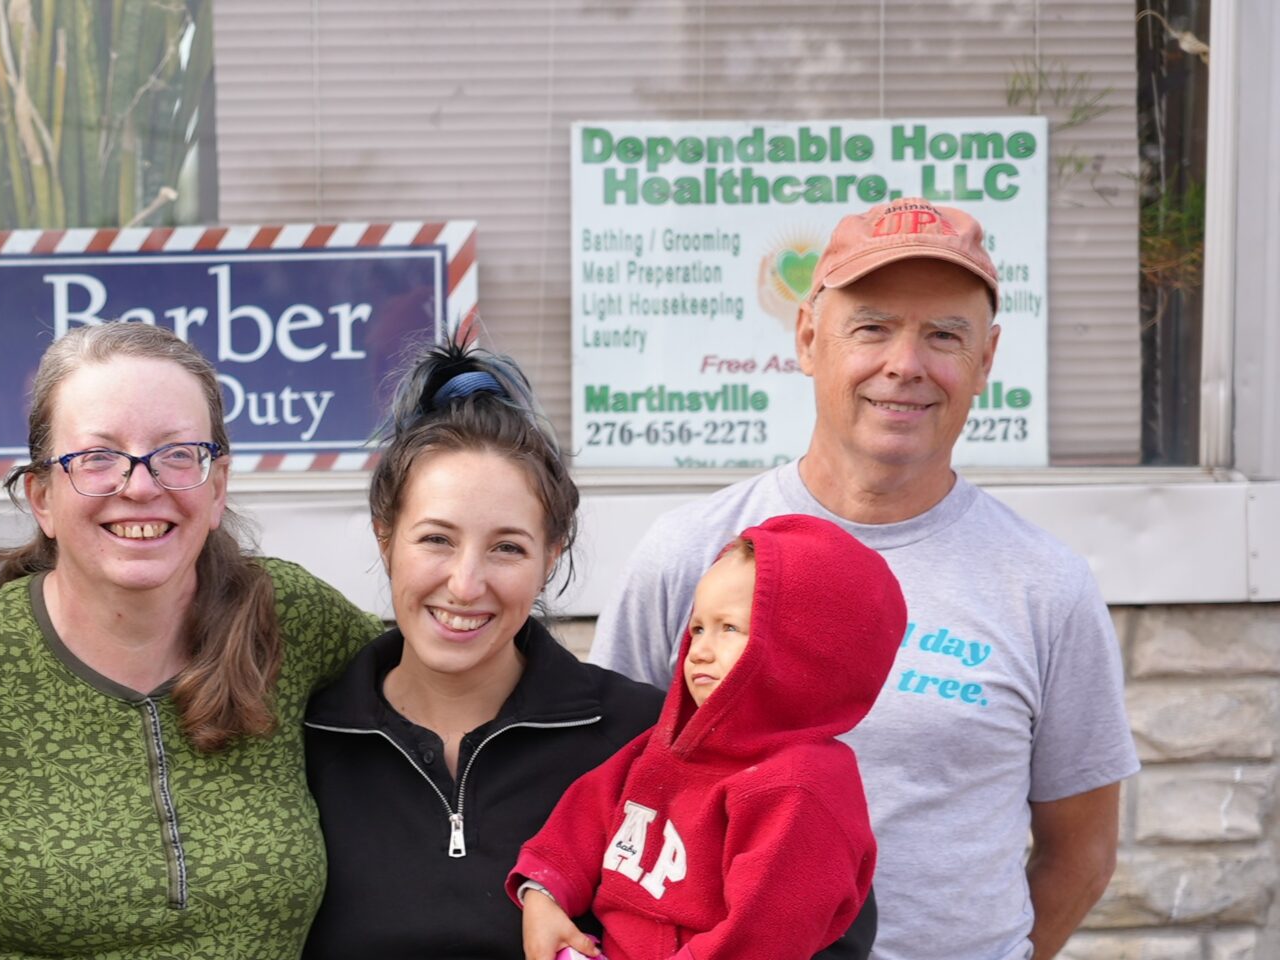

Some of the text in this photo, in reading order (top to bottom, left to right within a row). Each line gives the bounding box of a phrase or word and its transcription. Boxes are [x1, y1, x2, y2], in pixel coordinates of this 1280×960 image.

[581, 124, 1037, 172] Dependable Home
[921, 162, 1020, 201] LLC
[582, 229, 643, 257] Bathing
[663, 228, 741, 257] Grooming
[582, 261, 620, 284] Meal
[582, 293, 744, 320] Light Housekeeping
[582, 325, 647, 352] Laundry
[700, 354, 758, 374] Free
[216, 373, 335, 441] Duty
[584, 383, 769, 413] Martinsville
[586, 420, 768, 446] 276-656-2273
[919, 628, 992, 667] day
[897, 669, 988, 706] tree.
[602, 800, 687, 900] AP
[615, 840, 638, 857] baby
